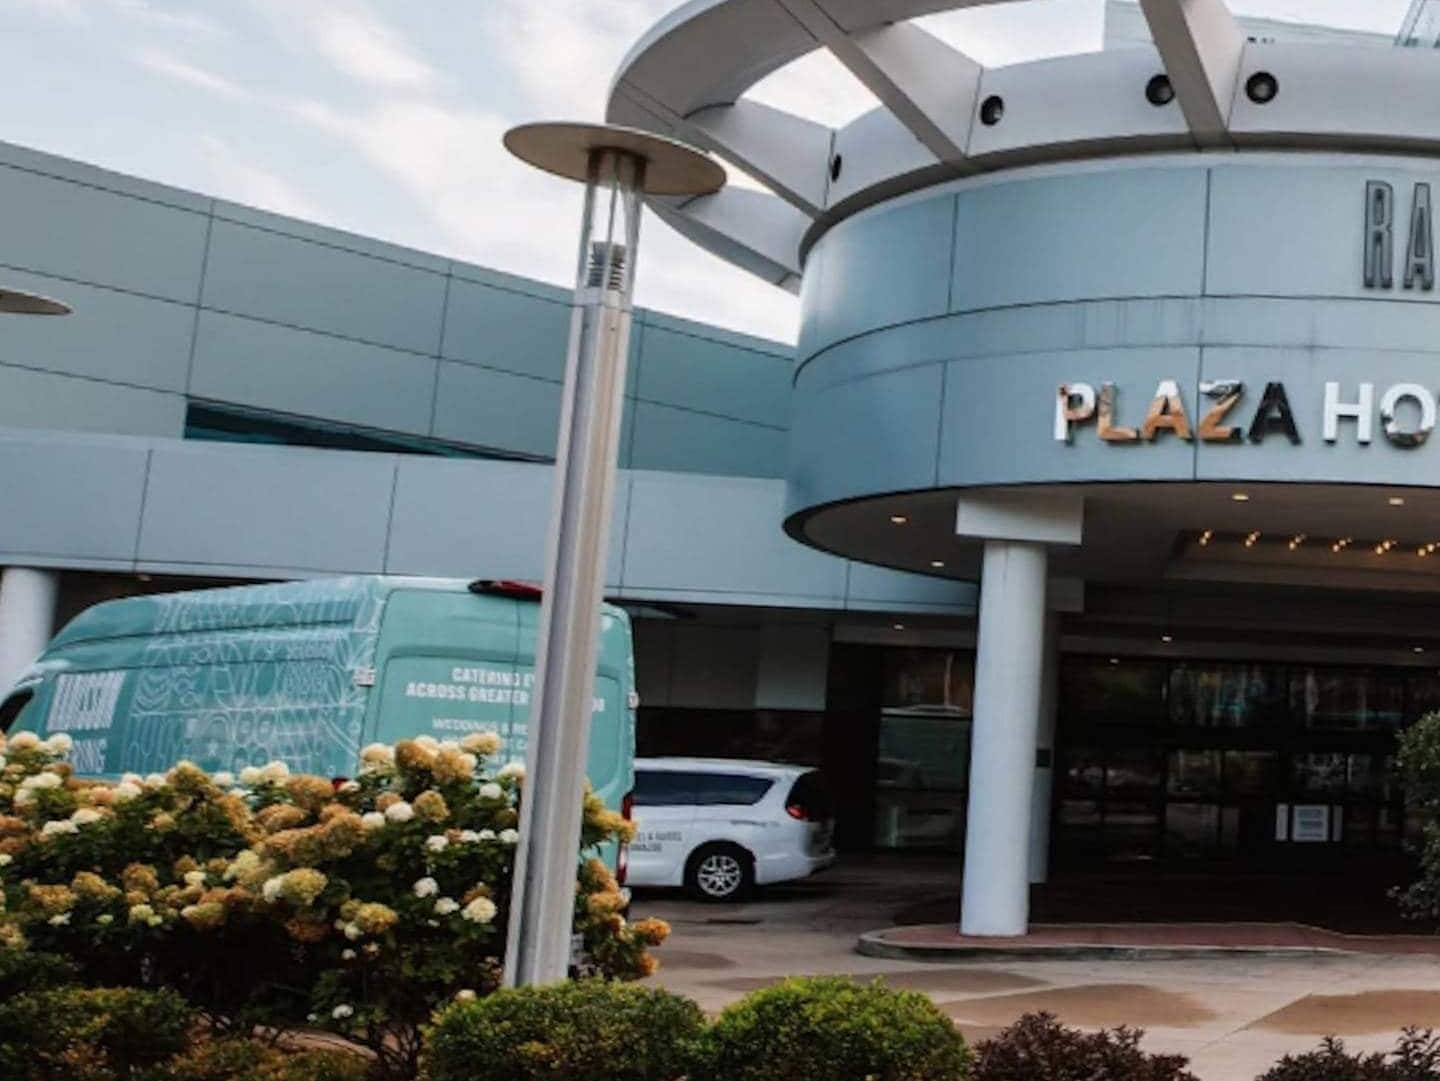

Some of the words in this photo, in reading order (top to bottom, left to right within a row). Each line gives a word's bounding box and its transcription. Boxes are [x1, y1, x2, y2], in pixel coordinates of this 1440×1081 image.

[1053, 379, 1301, 446] PLAZA
[405, 681, 467, 701] ACROSS
[469, 687, 530, 706] GREATER
